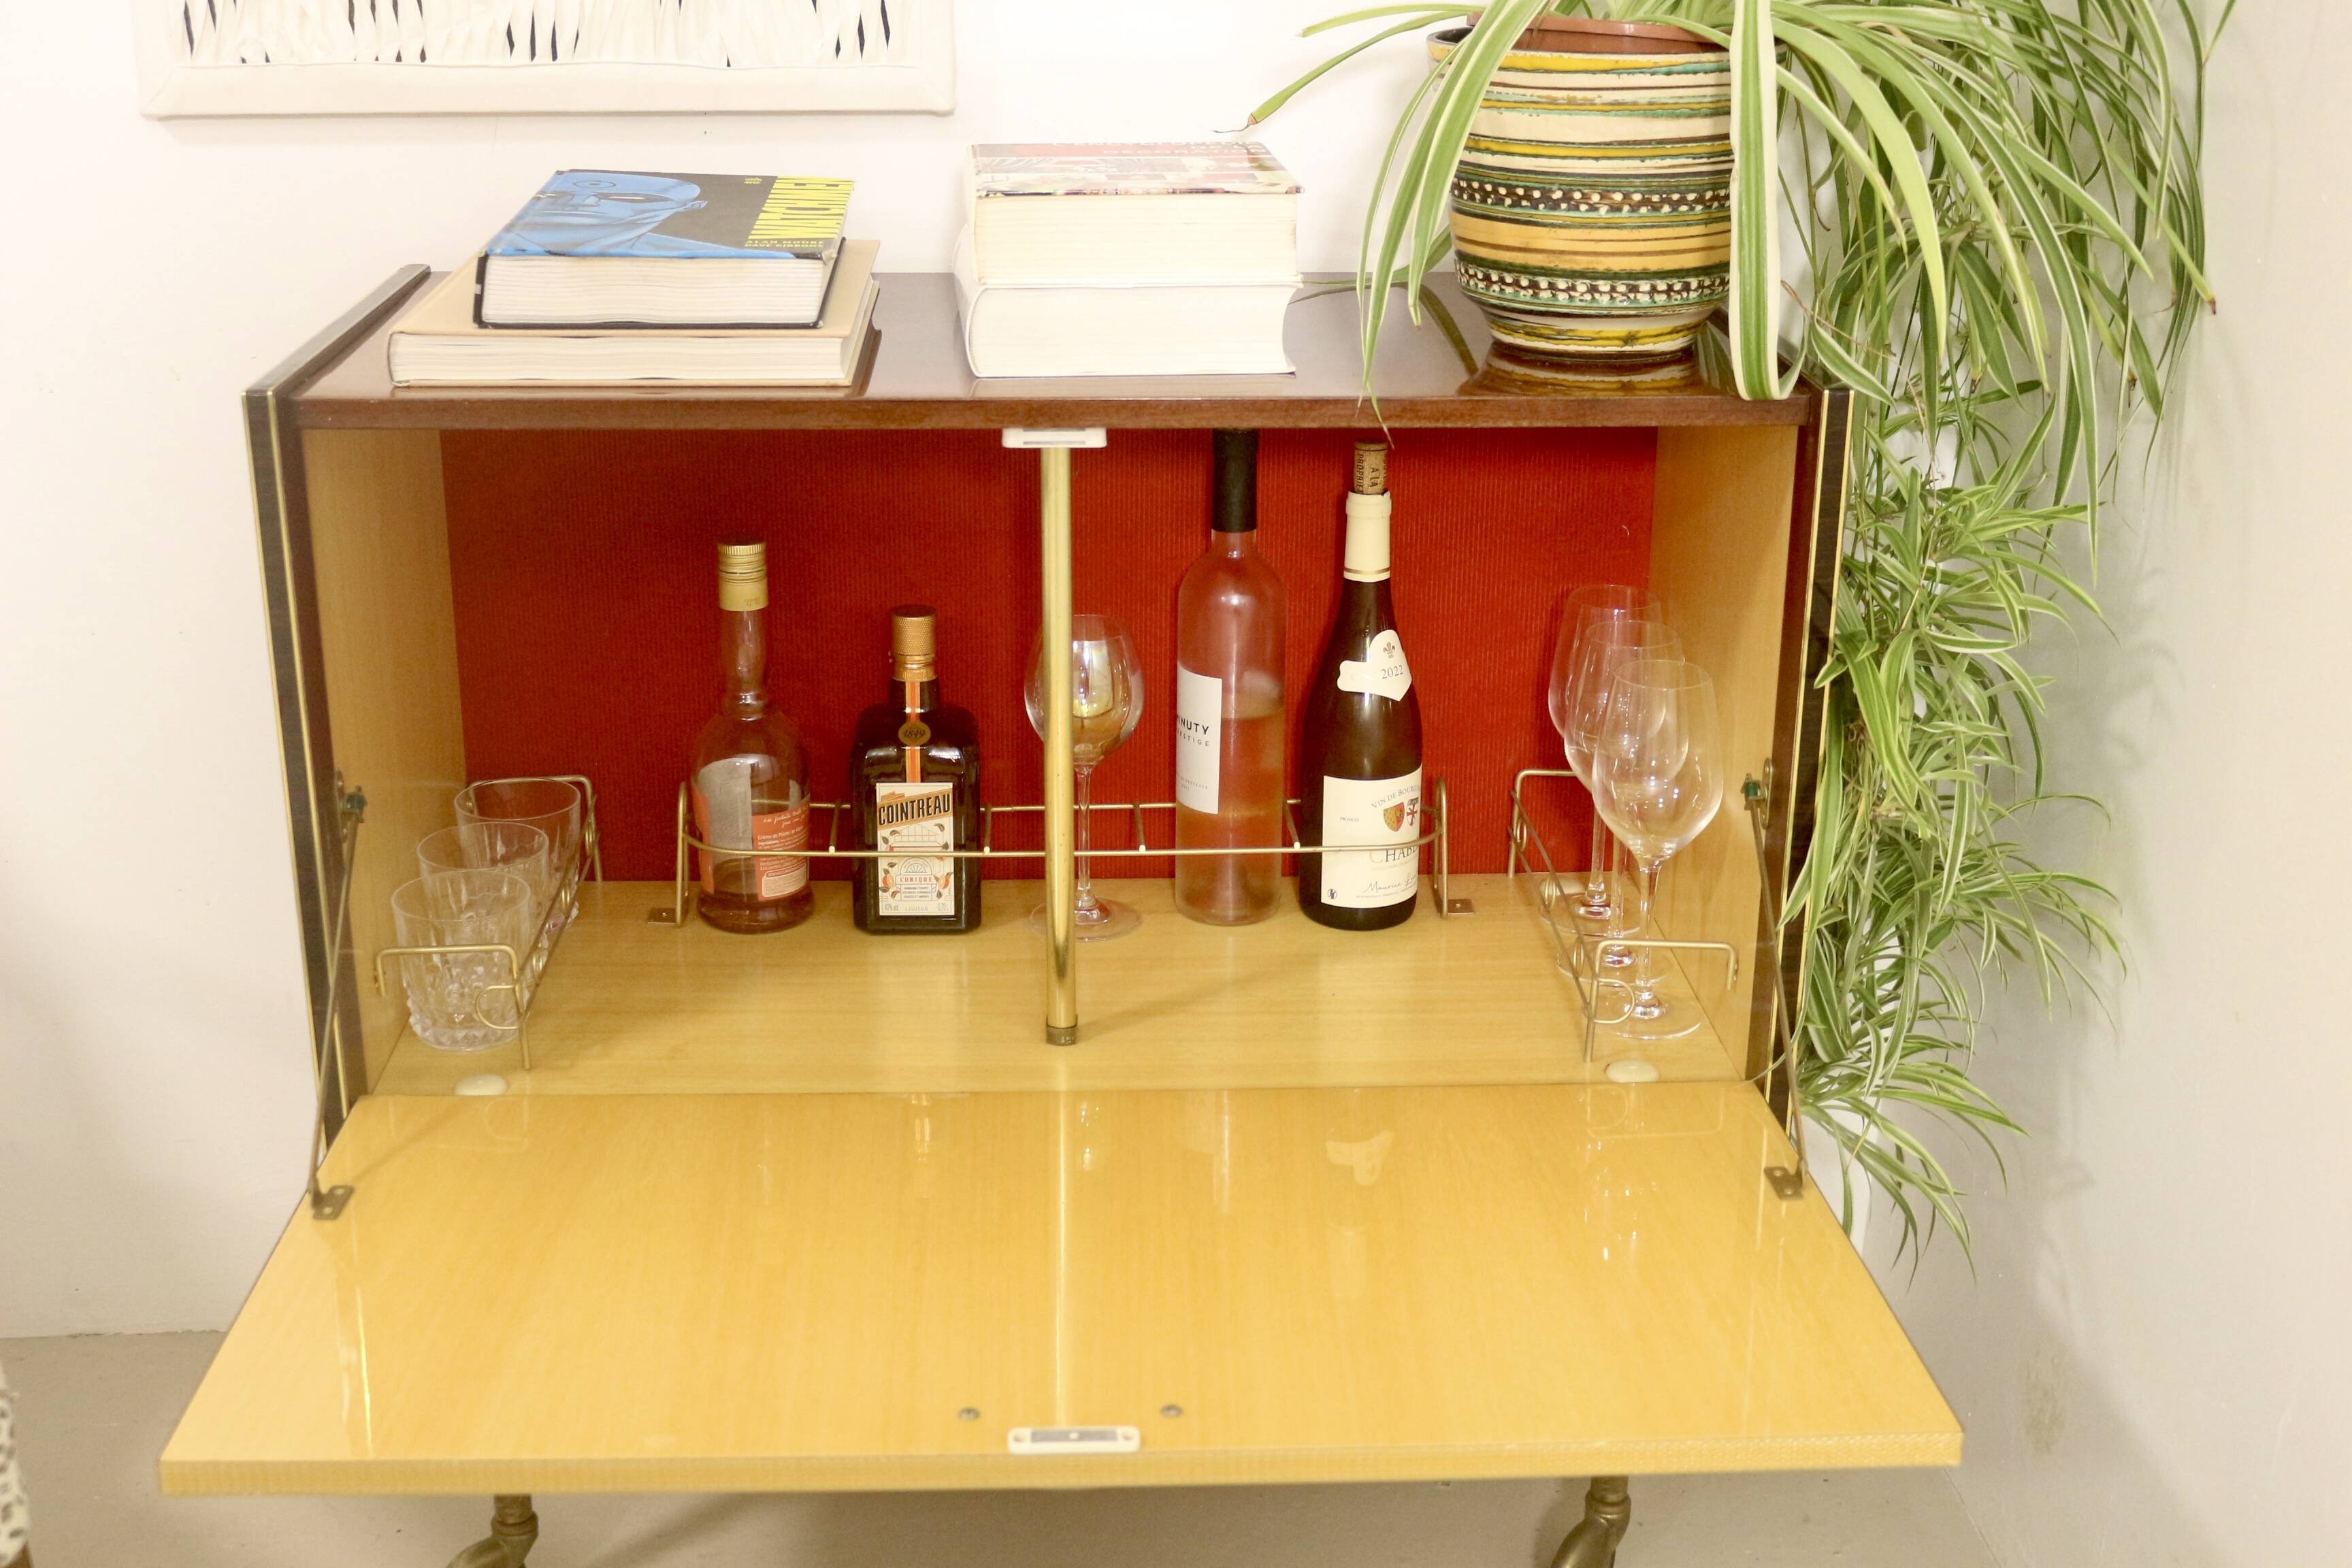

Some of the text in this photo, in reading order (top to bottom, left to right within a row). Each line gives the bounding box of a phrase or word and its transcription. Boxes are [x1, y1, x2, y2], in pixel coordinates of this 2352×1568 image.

[1380, 664, 1403, 679] 2022
[1371, 798, 1387, 808] VIN
[1387, 791, 1397, 801] DE
[879, 793, 951, 826] COINTREAU
